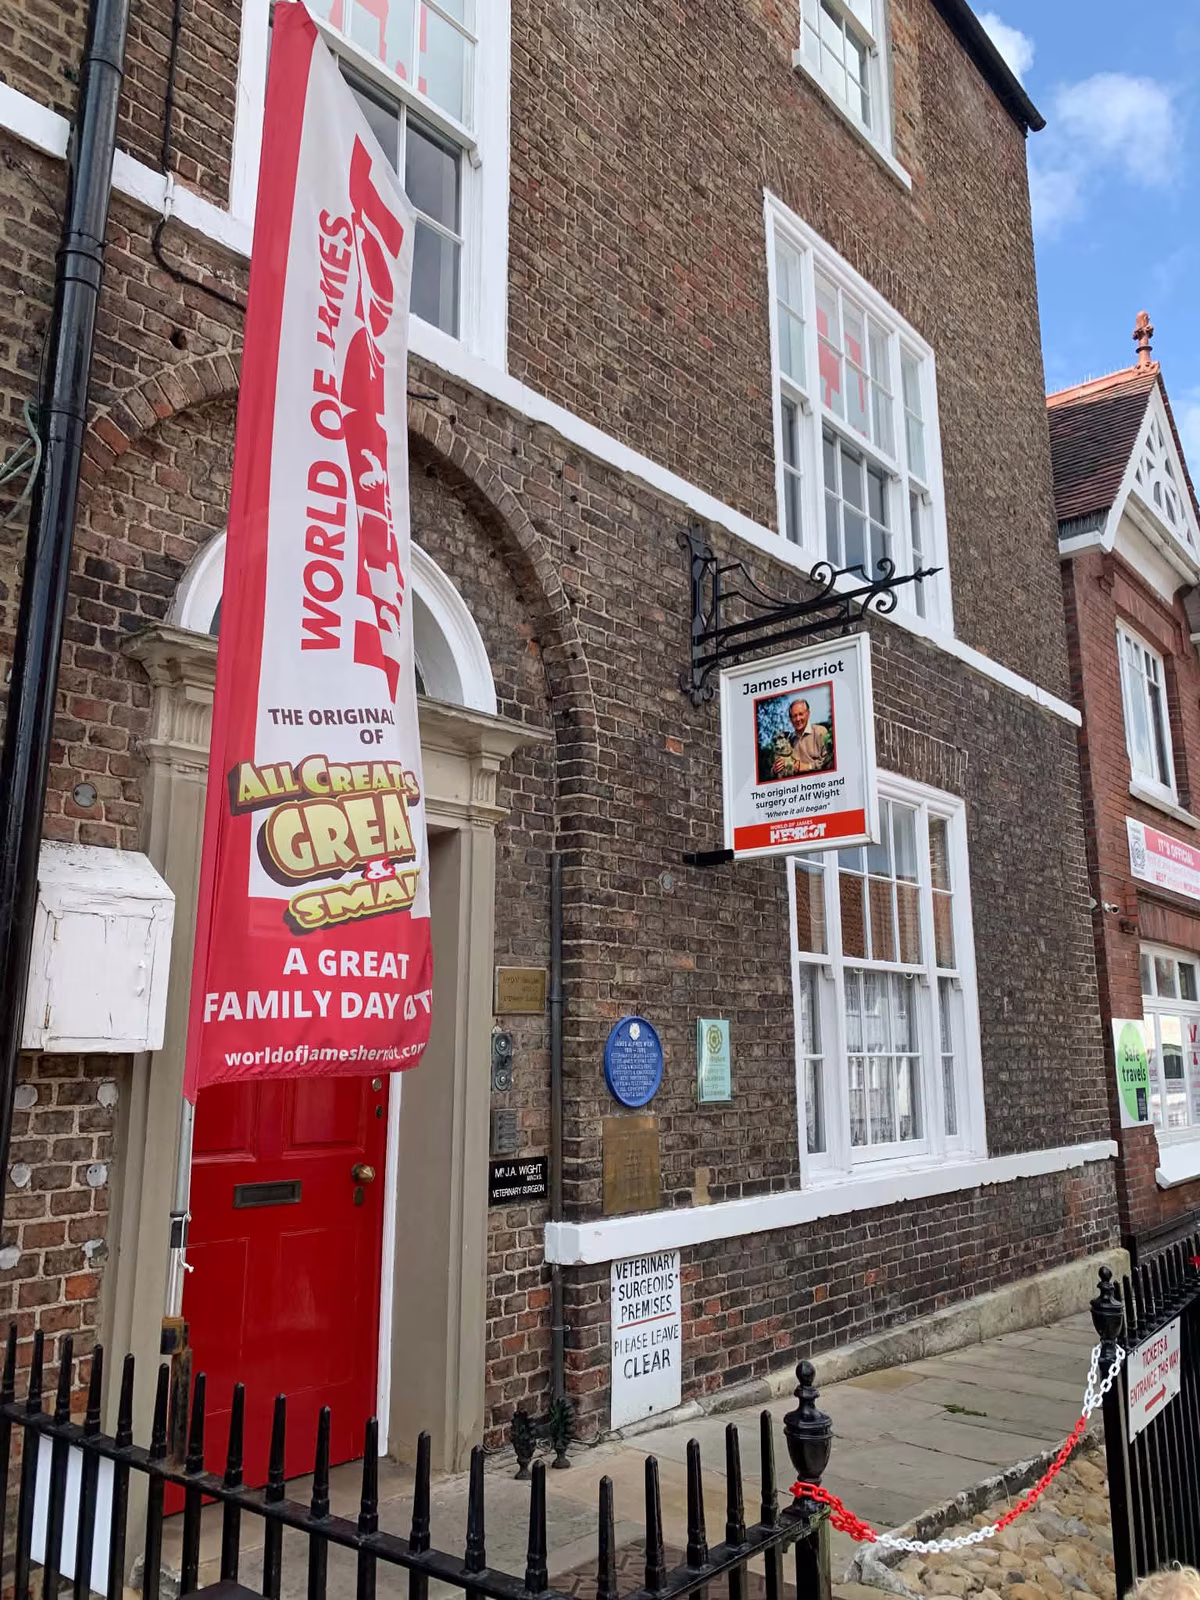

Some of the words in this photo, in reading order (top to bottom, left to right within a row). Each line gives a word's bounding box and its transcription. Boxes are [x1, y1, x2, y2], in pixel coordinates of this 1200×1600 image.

[316, 208, 353, 352] JAMES
[310, 369, 345, 441] OF
[301, 459, 348, 651] WORLD
[742, 675, 788, 696] James
[791, 659, 845, 684] Herriot
[267, 708, 304, 726] THE
[359, 728, 384, 745] OF
[750, 791, 766, 800] The
[767, 784, 799, 798] original
[800, 780, 826, 792] home
[827, 776, 845, 788] and
[755, 797, 787, 809] surgery
[788, 794, 799, 804] of
[799, 791, 812, 802] Alf
[812, 788, 841, 800] Wight
[795, 806, 805, 814] all
[267, 793, 415, 875] GREA
[282, 947, 309, 975] A
[318, 949, 410, 979] GREAT
[203, 990, 332, 1023] FAMILY
[341, 991, 401, 1020] DAY
[1122, 1061, 1147, 1082] travels
[519, 1164, 542, 1175] WIGHT
[492, 1186, 522, 1198] VETERINARY
[522, 1184, 545, 1194] SURGEON
[615, 1252, 677, 1281] VETERINARY
[618, 1273, 674, 1303] SURGEONS
[621, 1294, 673, 1324] PREMISES
[614, 1332, 649, 1358] PLEASE
[651, 1323, 680, 1347] LEAVE
[1142, 1338, 1163, 1369] TICKETS
[623, 1347, 672, 1380] CLEAR
[1130, 1367, 1157, 1408] ENTRANCE
[1158, 1357, 1169, 1381] THIS
[1169, 1348, 1180, 1370] WAY
